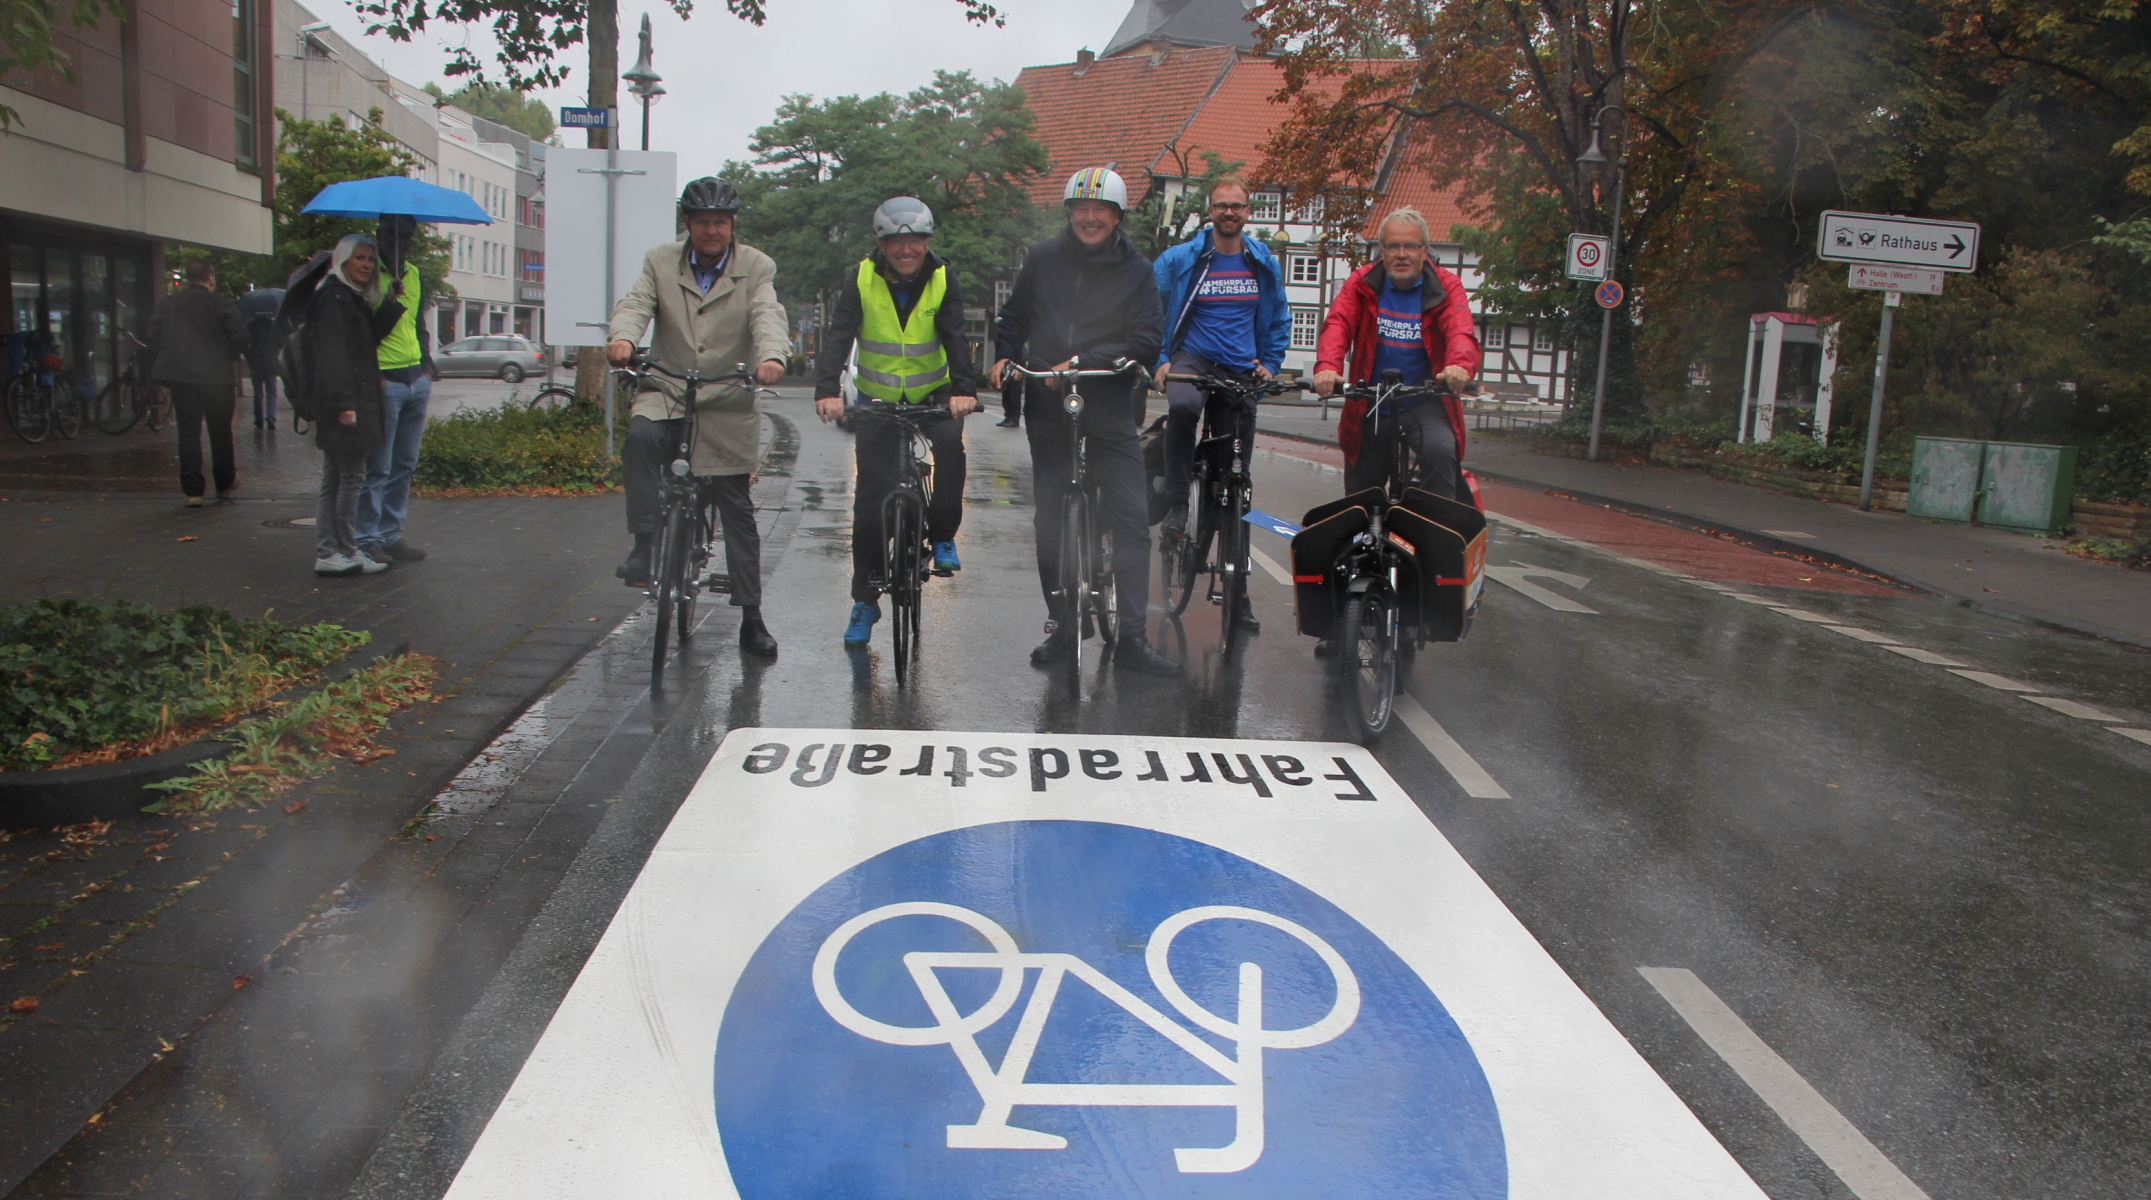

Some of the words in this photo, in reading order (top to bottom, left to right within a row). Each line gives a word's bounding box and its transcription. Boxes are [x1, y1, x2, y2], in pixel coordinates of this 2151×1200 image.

[564, 110, 605, 125] Domhof
[1880, 234, 1938, 251] Rathaus
[1581, 248, 1596, 260] 30
[1577, 267, 1596, 275] ZONE
[1869, 269, 1888, 278] Halle
[1868, 279, 1898, 288] Zentrum
[1211, 285, 1259, 295] FÜRSRAD
[1378, 325, 1422, 340] FÜRSRA
[742, 742, 1378, 801] Fahrradstraße
